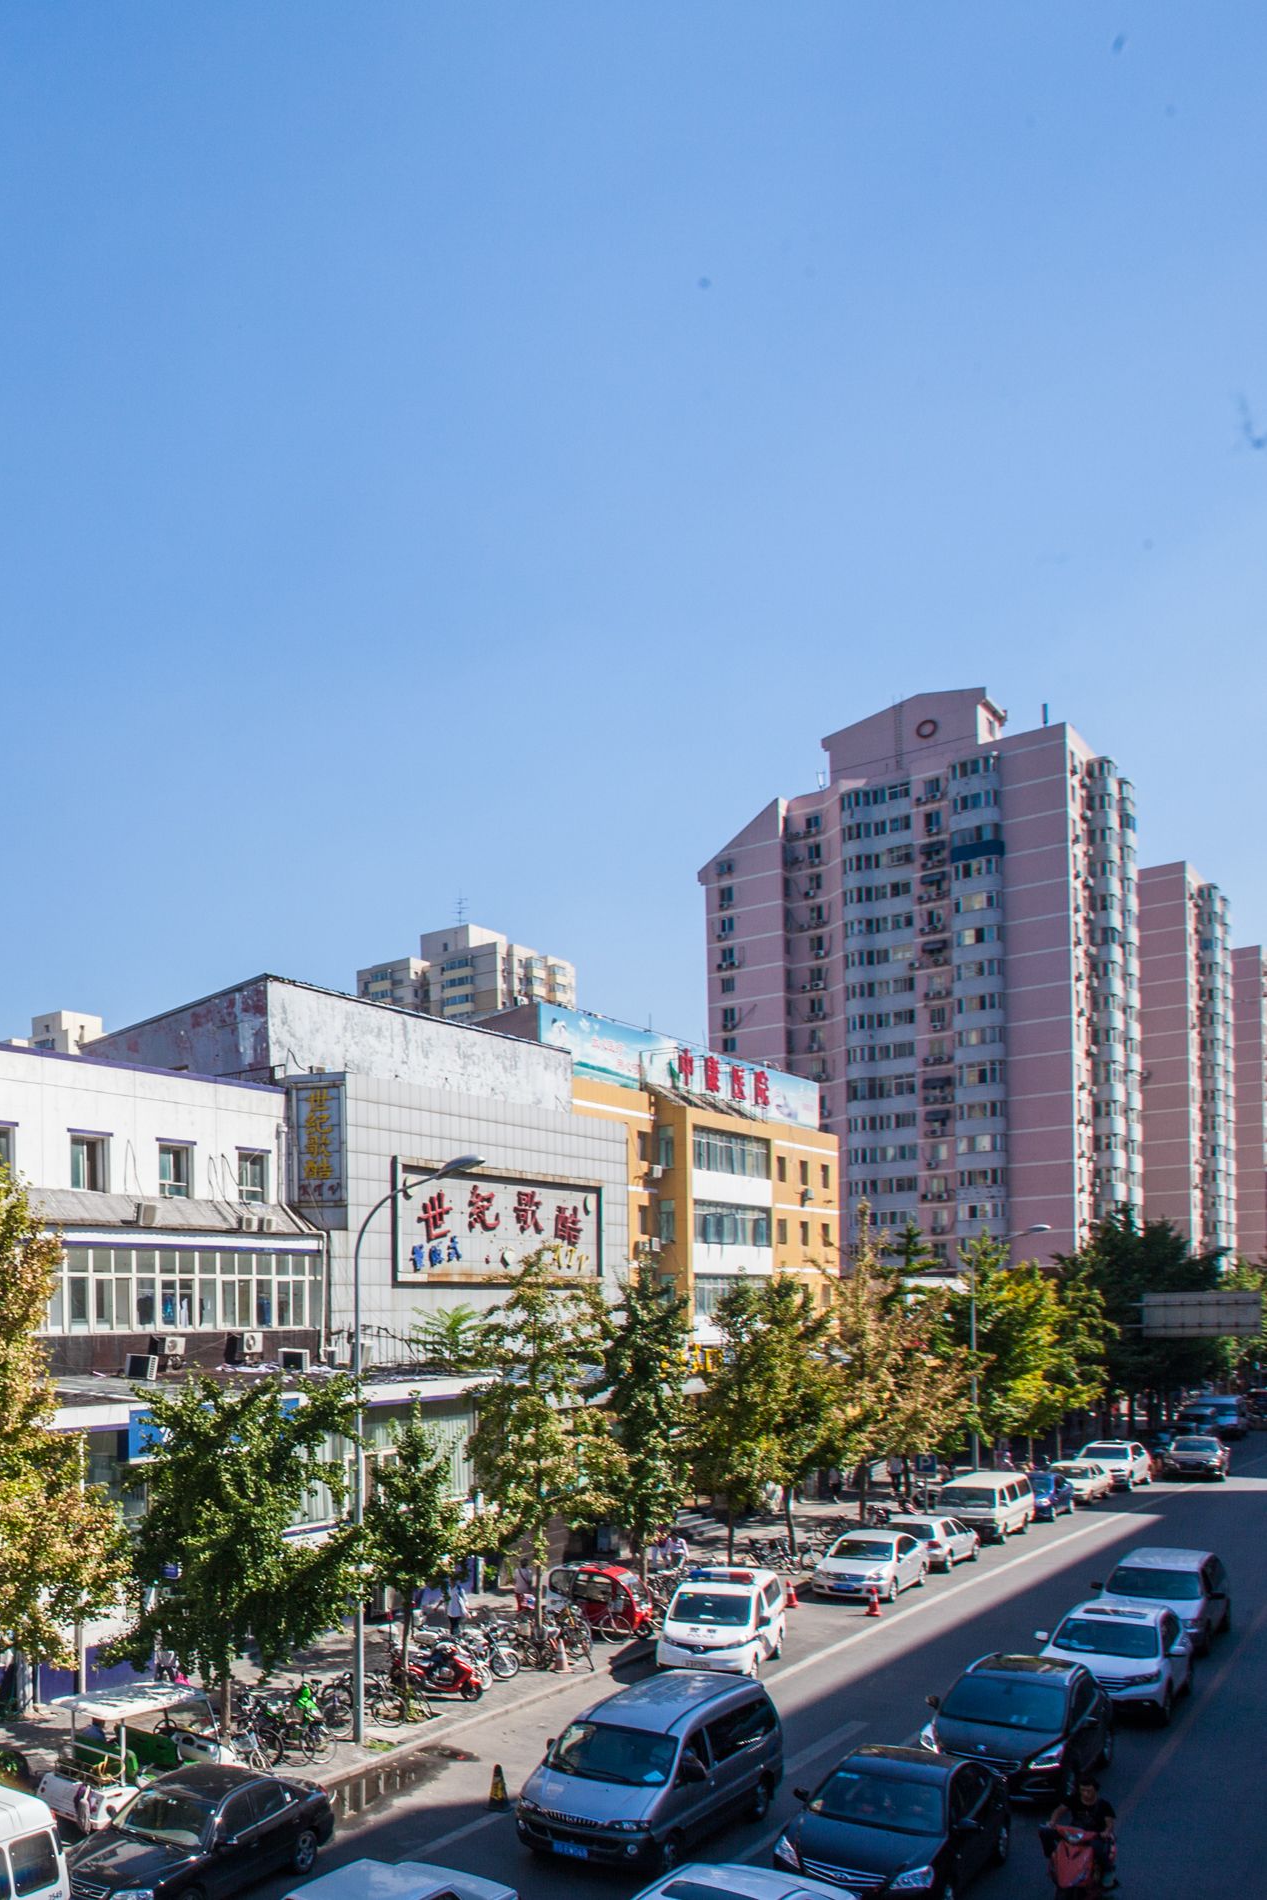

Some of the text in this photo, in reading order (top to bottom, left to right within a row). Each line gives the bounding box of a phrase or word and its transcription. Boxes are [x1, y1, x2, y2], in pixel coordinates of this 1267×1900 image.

[304, 1087, 334, 1180] 世纪歌酷
[417, 1184, 584, 1247] 世纪歌酷
